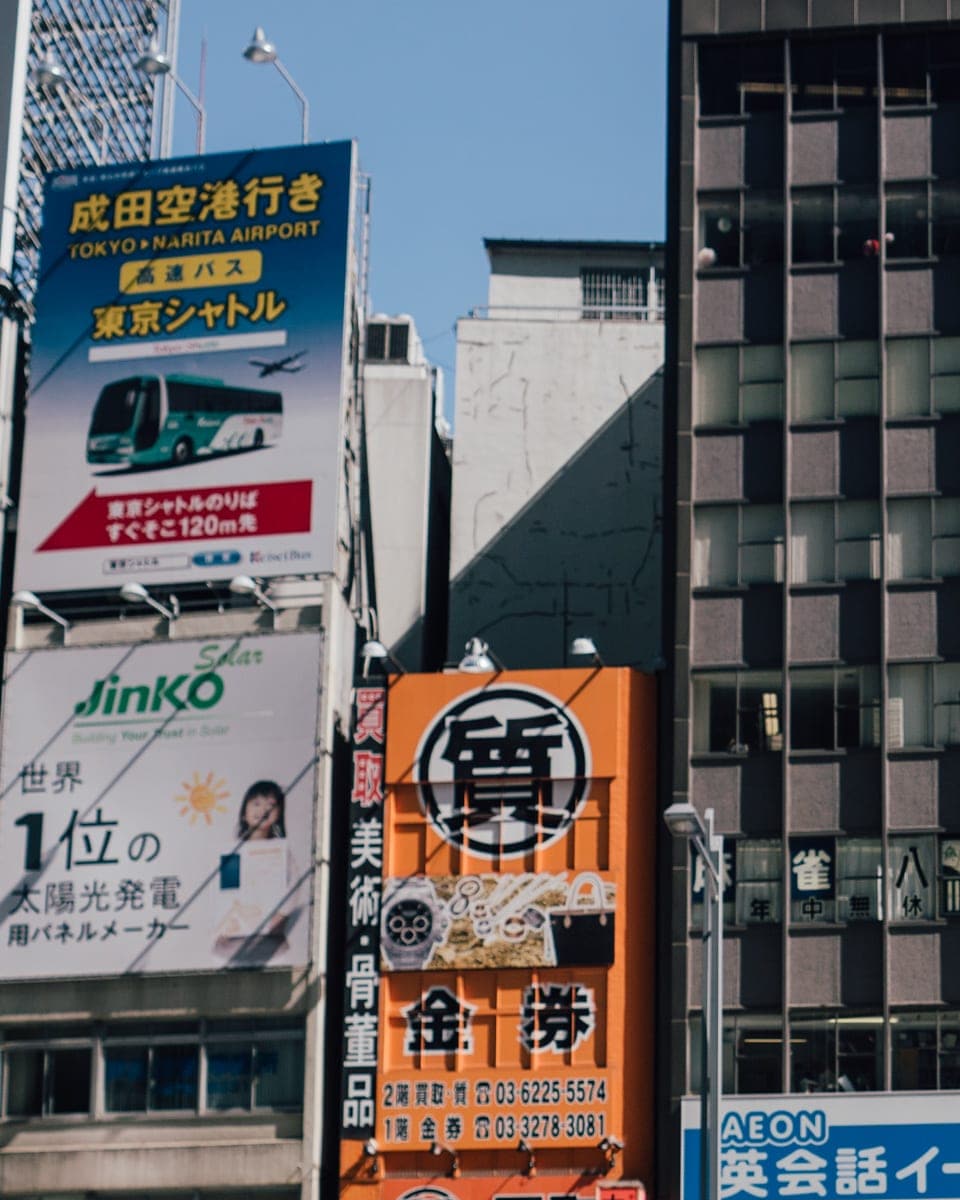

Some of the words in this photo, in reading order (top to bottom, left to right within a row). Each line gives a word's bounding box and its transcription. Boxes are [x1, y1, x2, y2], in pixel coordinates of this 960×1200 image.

[68, 172, 324, 234] 成田空港行き
[68, 238, 136, 259] TOKYO
[153, 230, 225, 252] NARITA
[230, 219, 321, 244] AIRPORT
[136, 257, 245, 285] 高速バス
[92, 290, 287, 340] 東京シャトル
[107, 489, 260, 520] 東京シャトルのりば
[105, 513, 258, 543] すぐそこ120m先
[19, 760, 83, 794] 世界
[14, 807, 161, 872] 1位の
[9, 875, 183, 916] 太陽光発電
[8, 917, 190, 946] 用パネルメーカー
[722, 1112, 825, 1142] AEON
